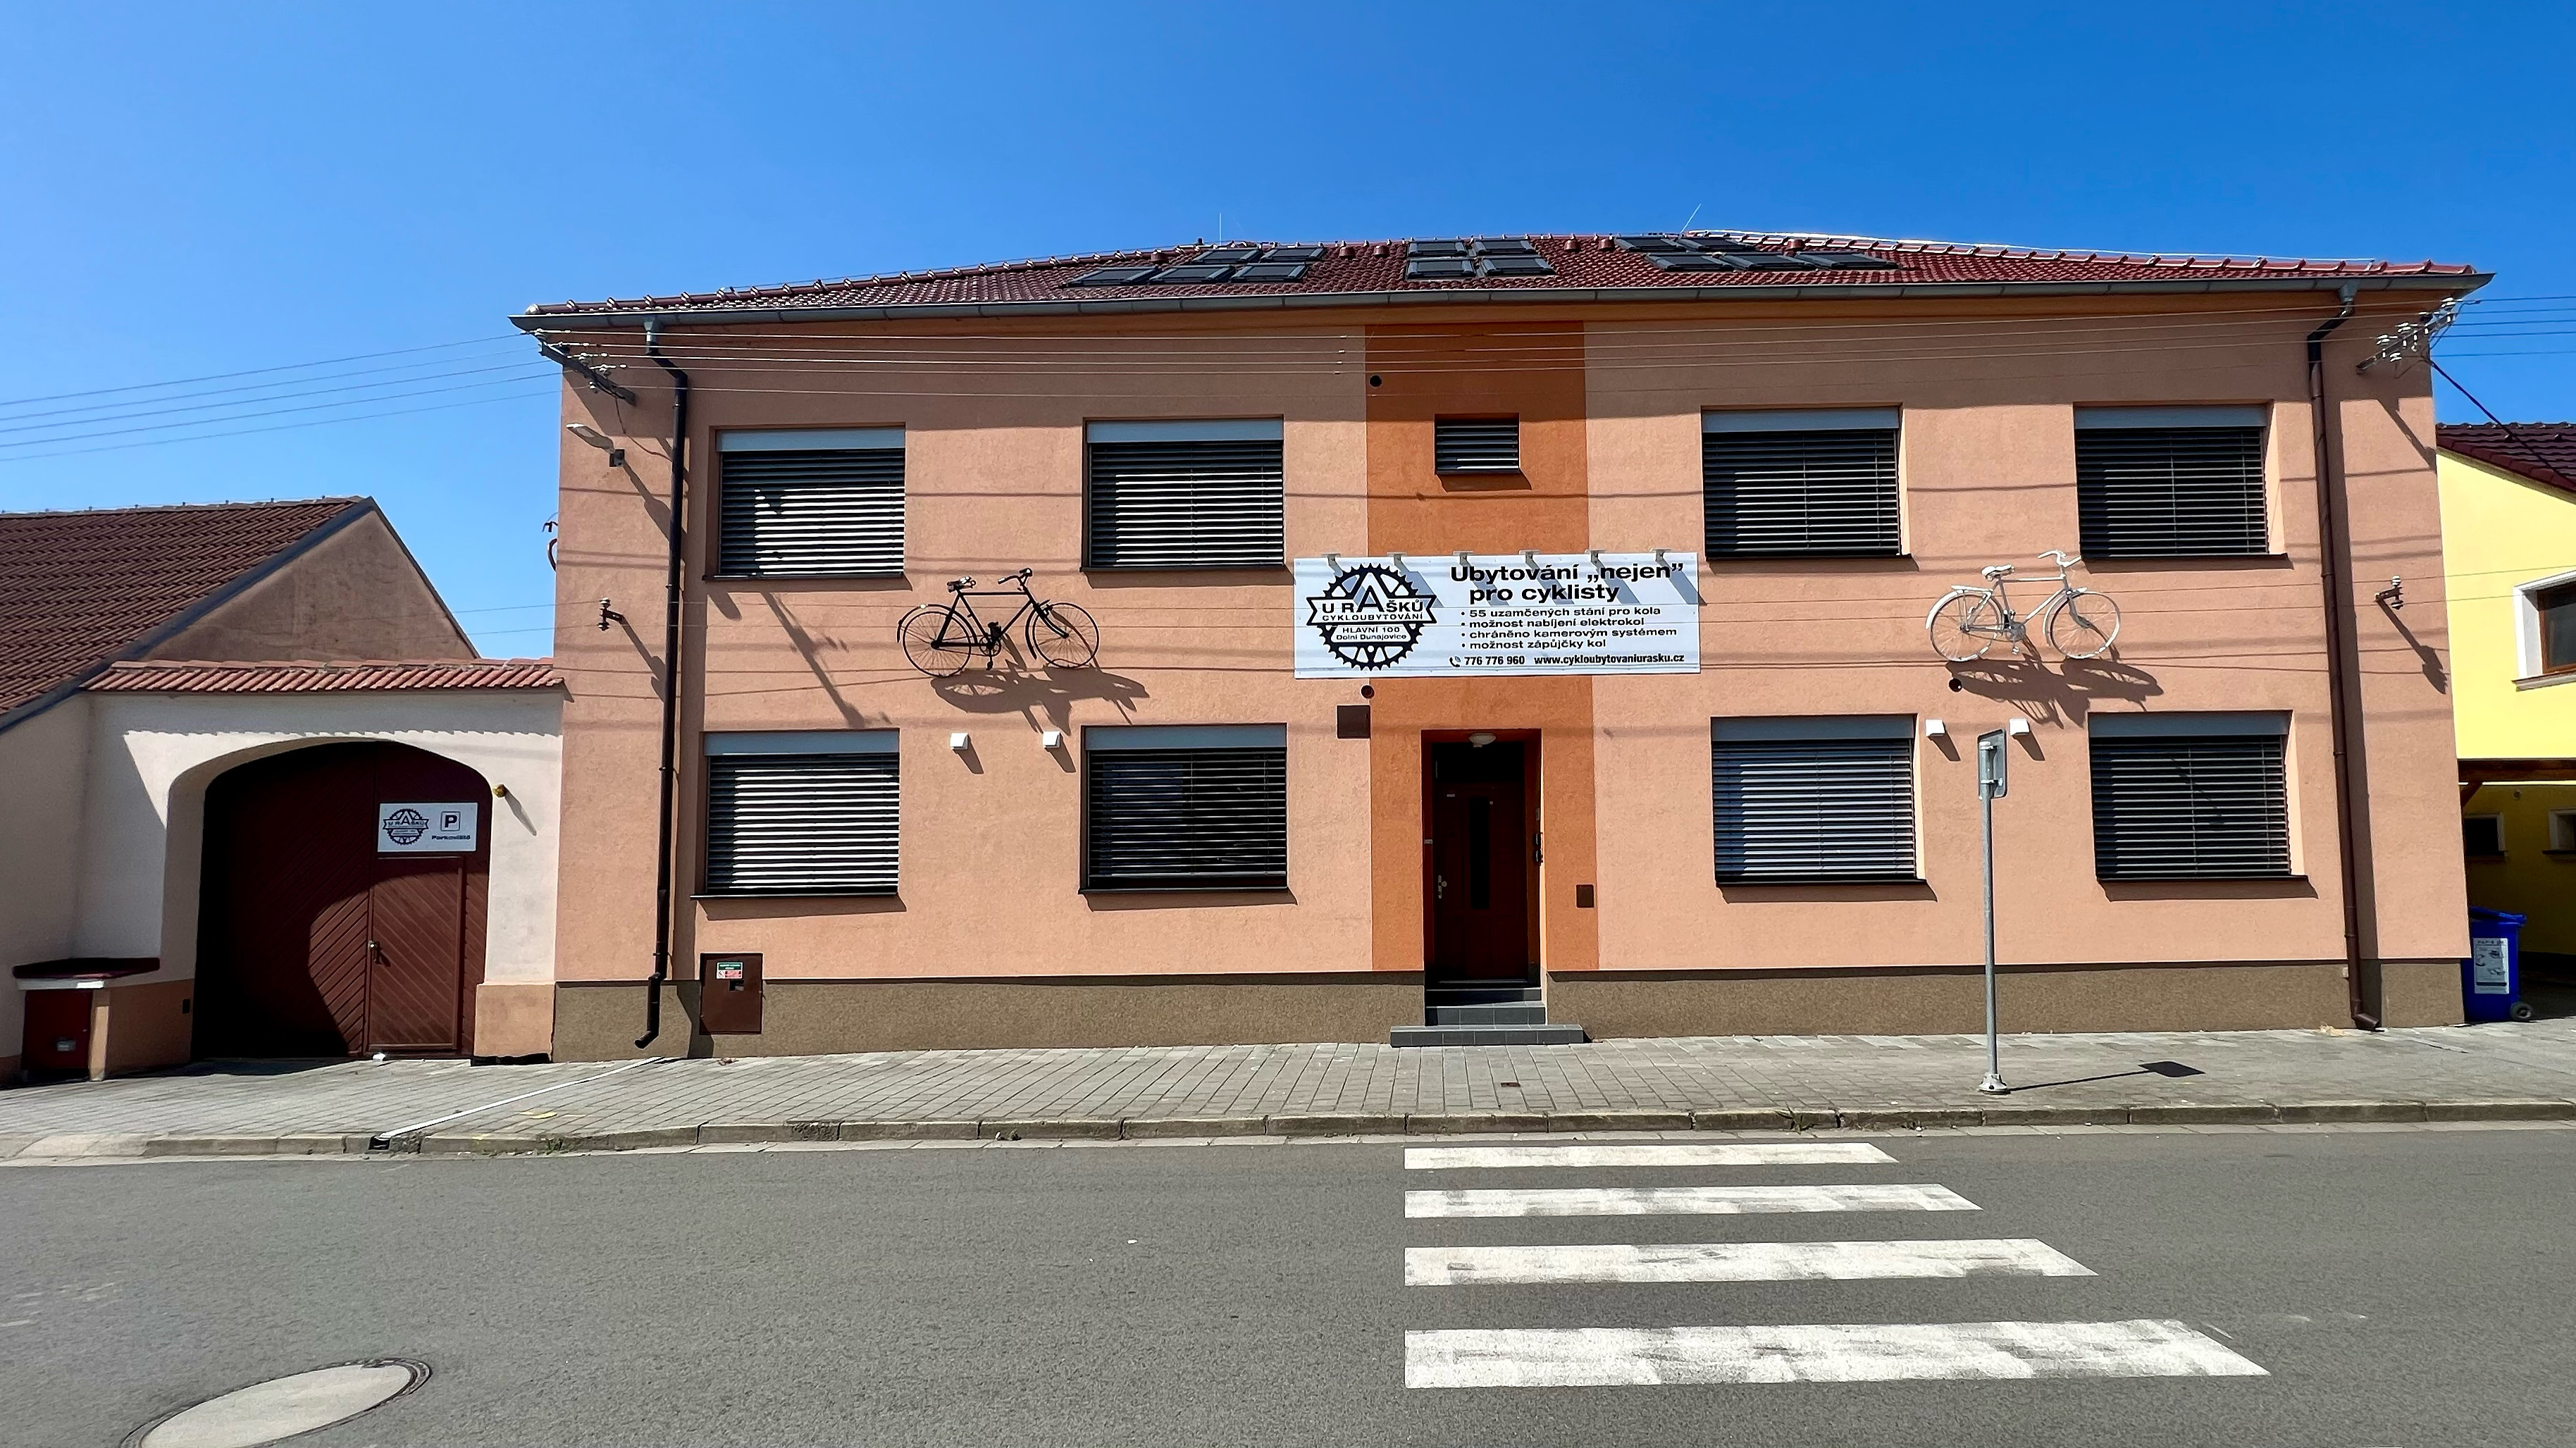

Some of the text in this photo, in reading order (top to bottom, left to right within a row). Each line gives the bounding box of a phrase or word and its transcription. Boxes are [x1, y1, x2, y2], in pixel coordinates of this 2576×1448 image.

[1451, 564, 1579, 585] Ubytování
[1470, 584, 1620, 605] pro cyklisty
[1322, 602, 1335, 614] U
[1490, 608, 1570, 618] uzamčených
[1573, 607, 1605, 616] stání
[1609, 608, 1630, 617] pro
[1634, 607, 1661, 615] kola
[1322, 612, 1423, 621] CYKLOUBYTOVÁNÍ
[1469, 617, 1645, 629] možnost nabíjení elektrokol
[1469, 628, 1677, 639] chráněno kamerovým systémem
[1470, 638, 1606, 650] možnost zápůjčky kol
[1464, 653, 1685, 666] 776 776 960 www.cykloubytovaniurasku.cz
[444, 815, 457, 828] P
